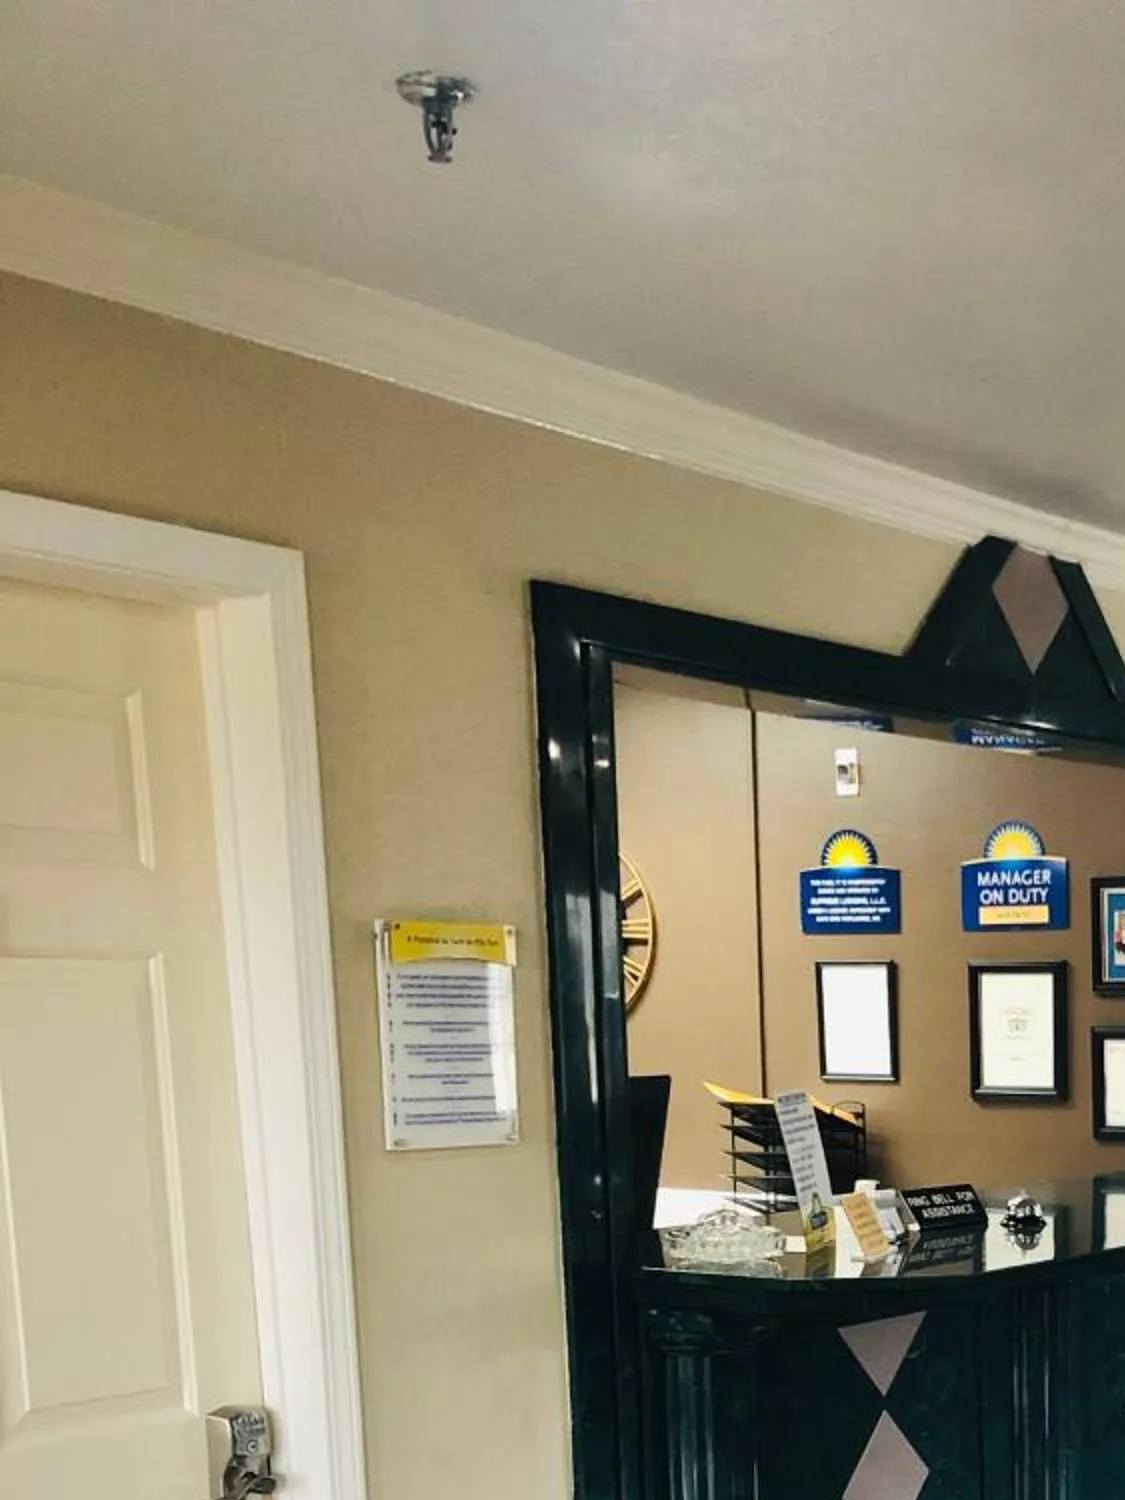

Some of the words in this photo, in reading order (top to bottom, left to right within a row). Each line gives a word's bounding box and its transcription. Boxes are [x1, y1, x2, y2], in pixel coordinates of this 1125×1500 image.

[977, 869, 1052, 887] MANAGER
[979, 889, 1004, 905] ON
[1008, 887, 1049, 904] DUTY
[906, 1195, 931, 1207] RING
[931, 1193, 955, 1205] BELL
[955, 1191, 975, 1201] FOR
